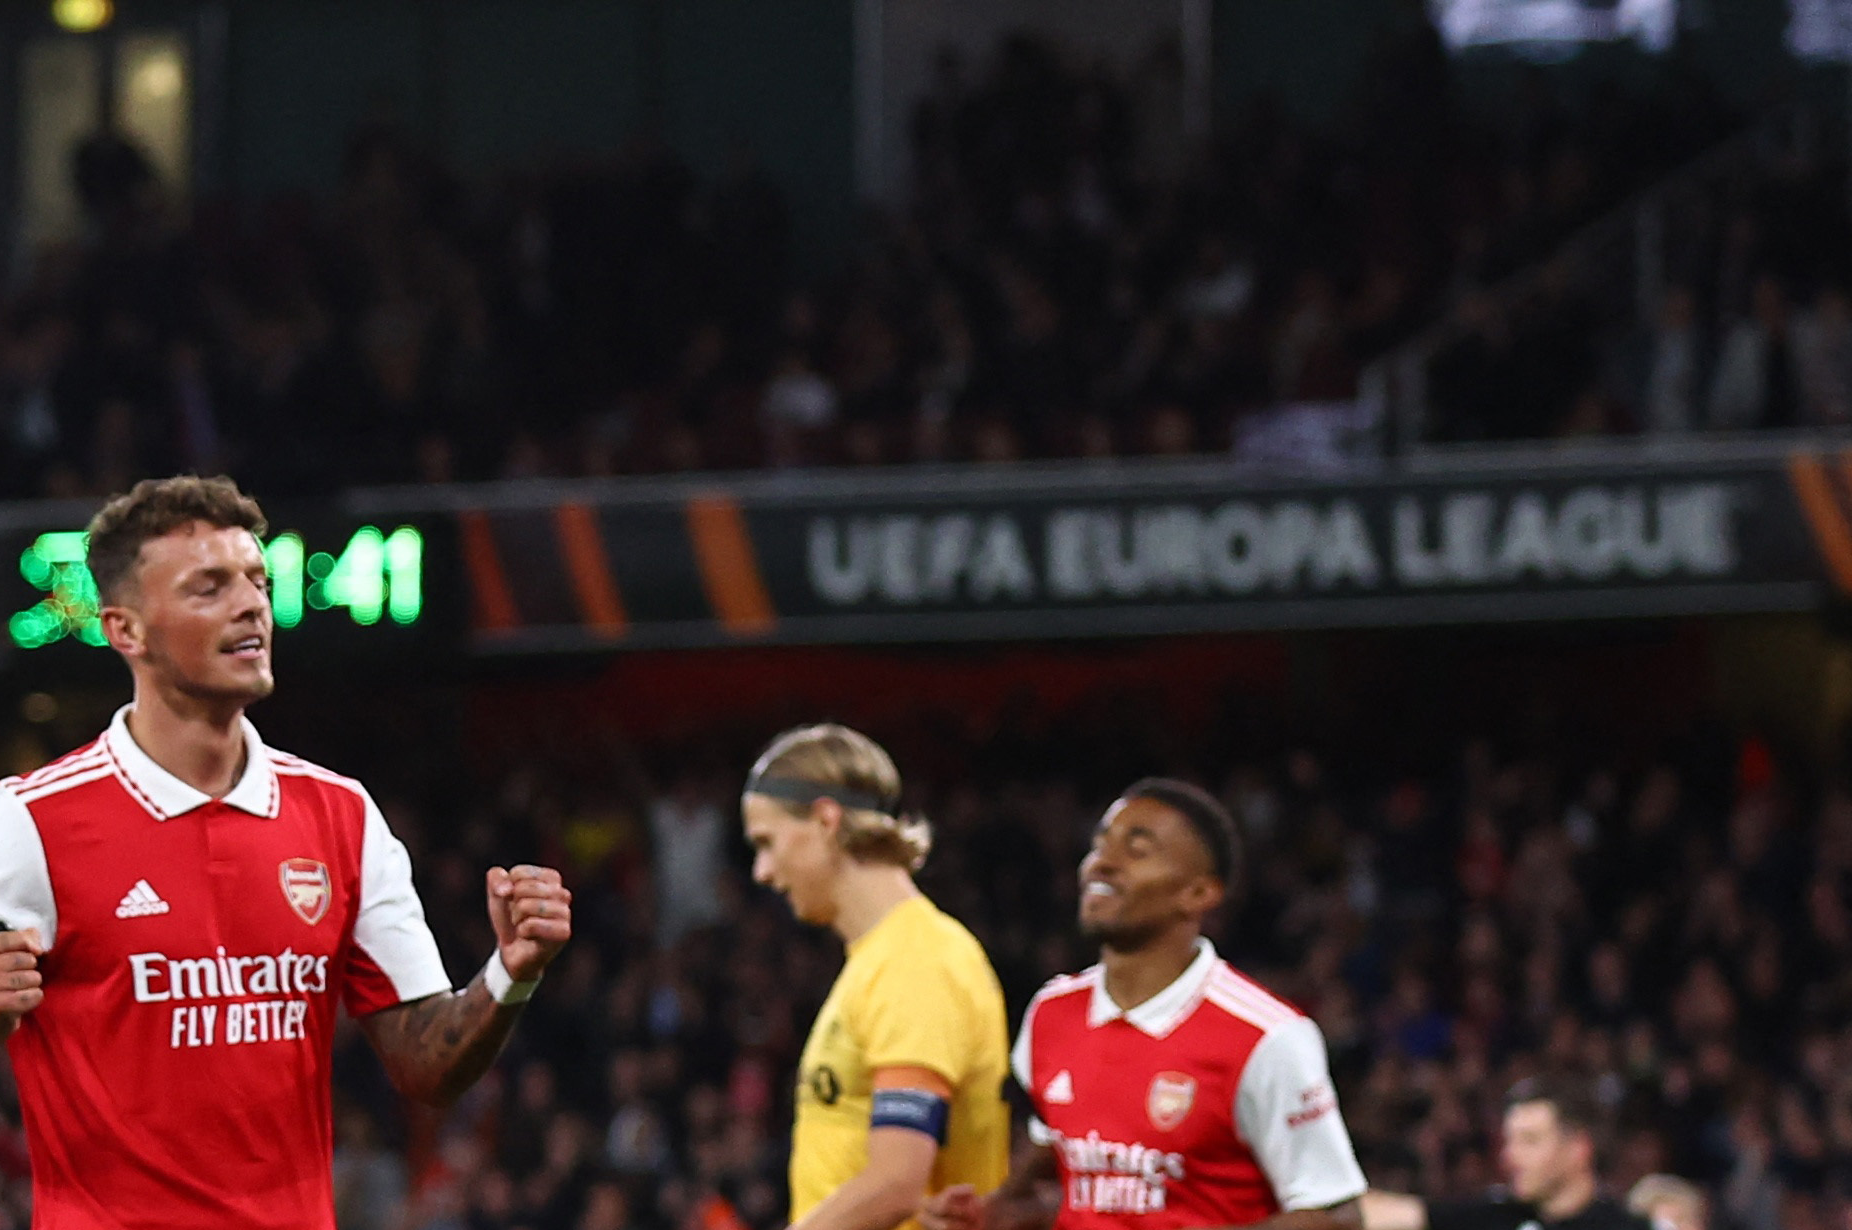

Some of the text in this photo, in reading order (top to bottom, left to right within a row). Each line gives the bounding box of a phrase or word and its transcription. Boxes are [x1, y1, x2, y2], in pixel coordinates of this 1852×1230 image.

[808, 484, 1738, 603] UEFA EUROPA LEAGUE
[128, 945, 329, 1003] Emirates
[171, 999, 307, 1049] FLY BETTER
